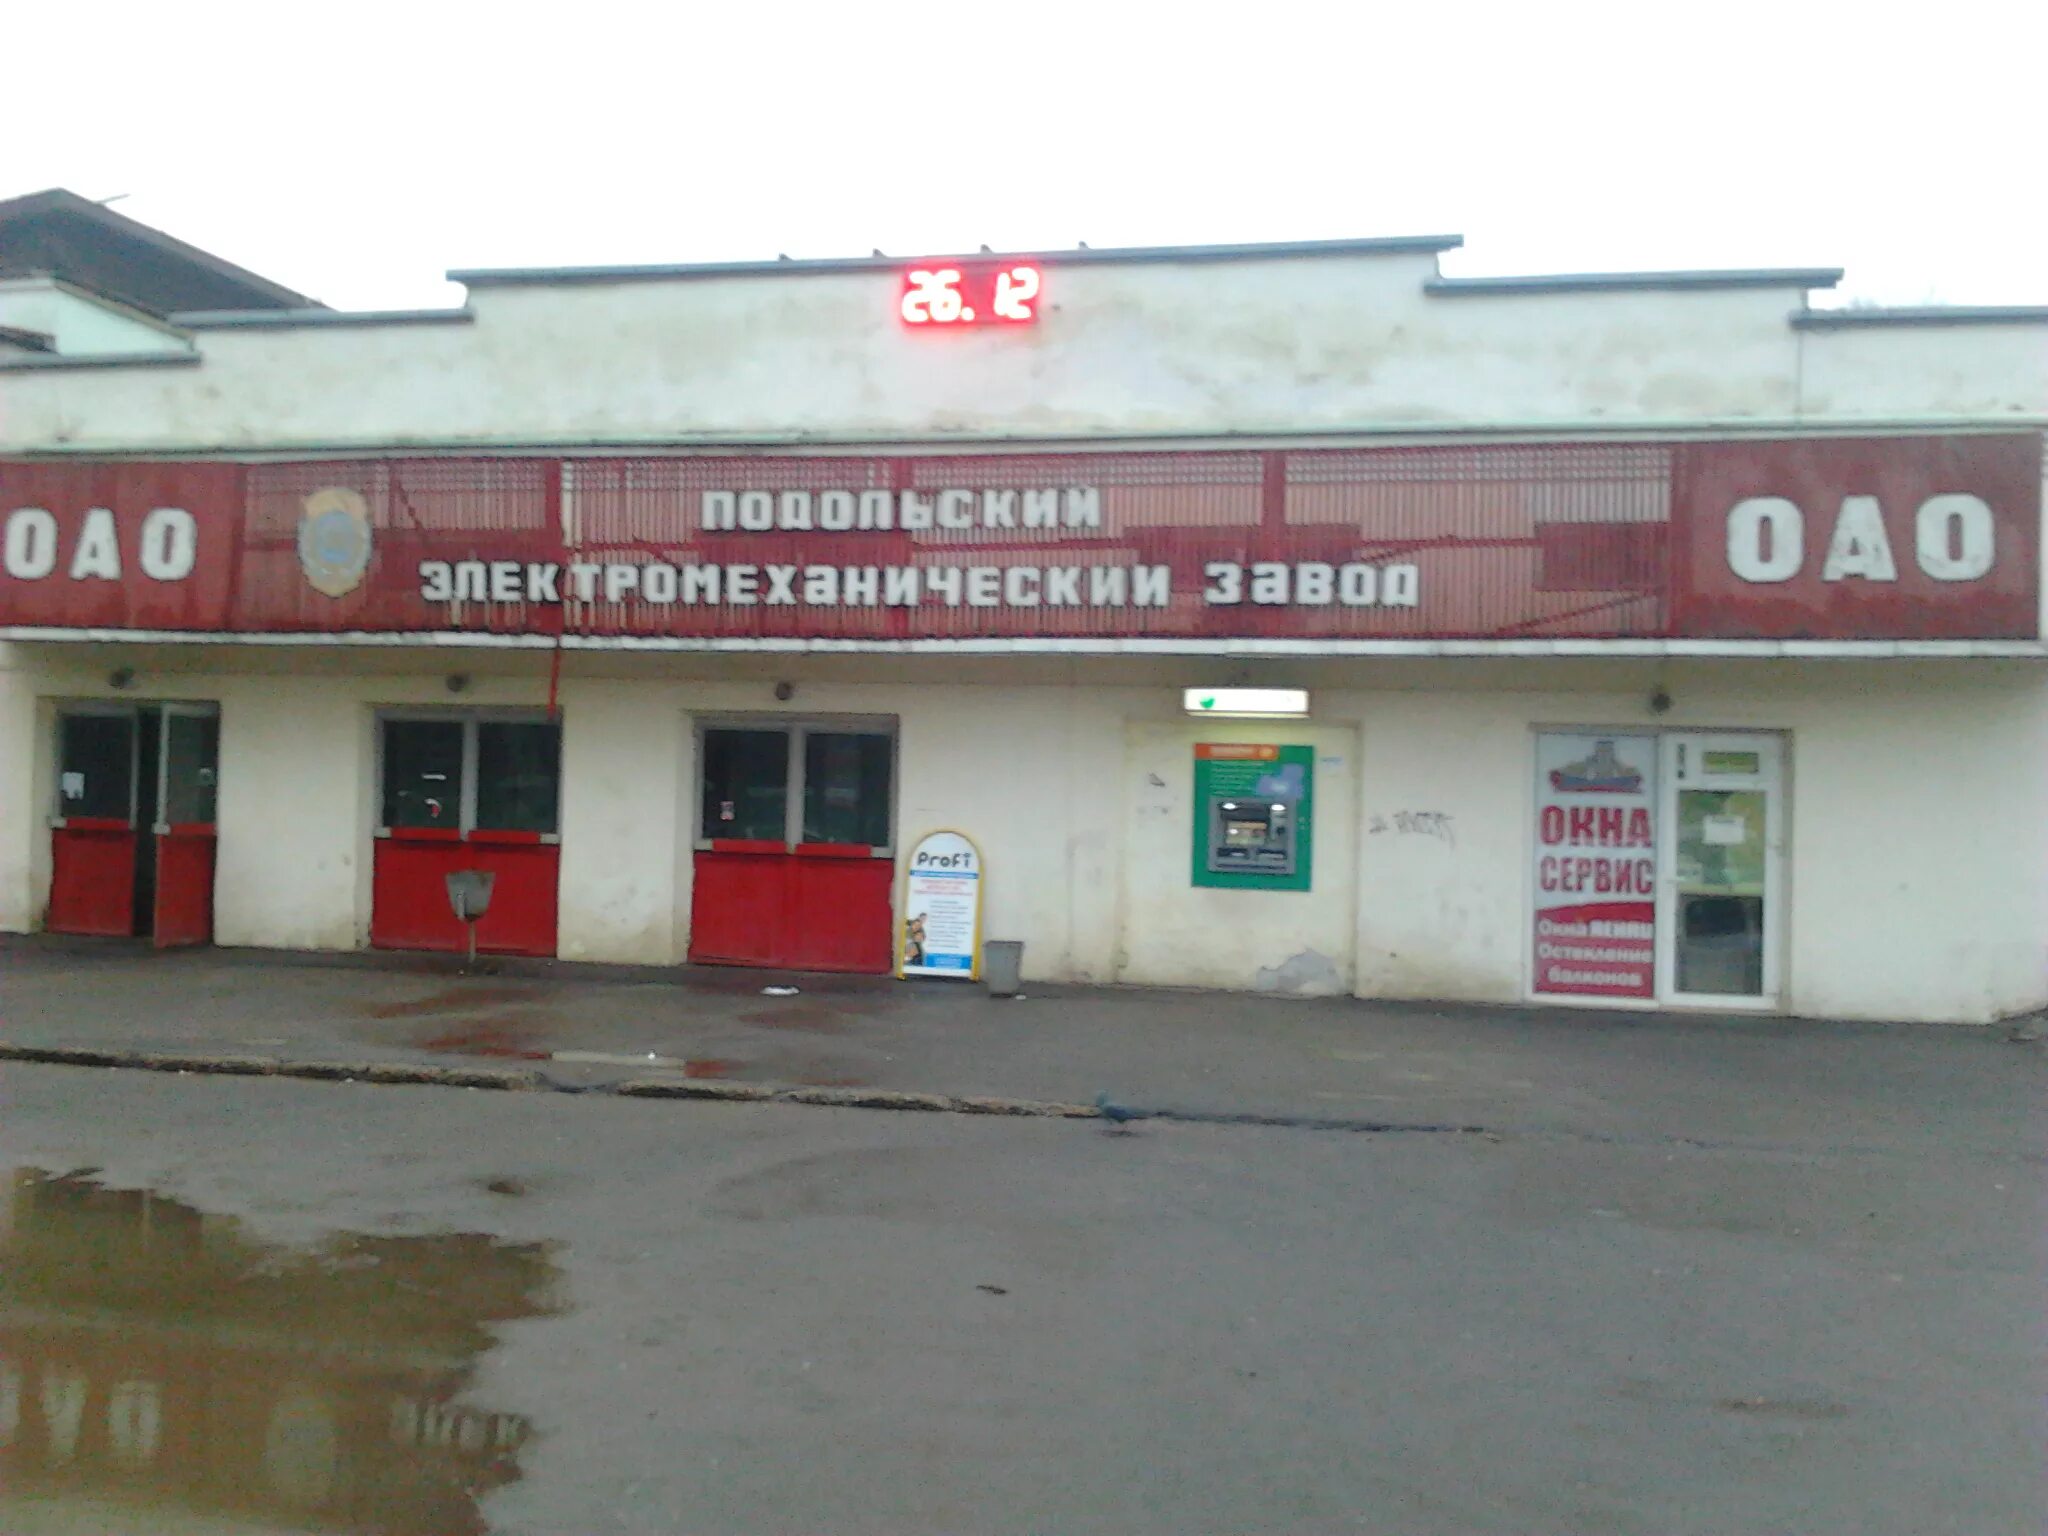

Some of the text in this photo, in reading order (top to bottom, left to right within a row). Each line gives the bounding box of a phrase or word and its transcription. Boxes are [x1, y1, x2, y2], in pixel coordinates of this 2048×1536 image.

[902, 266, 1040, 322] 26. 12
[5, 507, 197, 580] ОАО
[1726, 493, 1996, 583] ОАО
[1541, 805, 1652, 848] ОКНА
[1540, 855, 1653, 894] СЕРВИС
